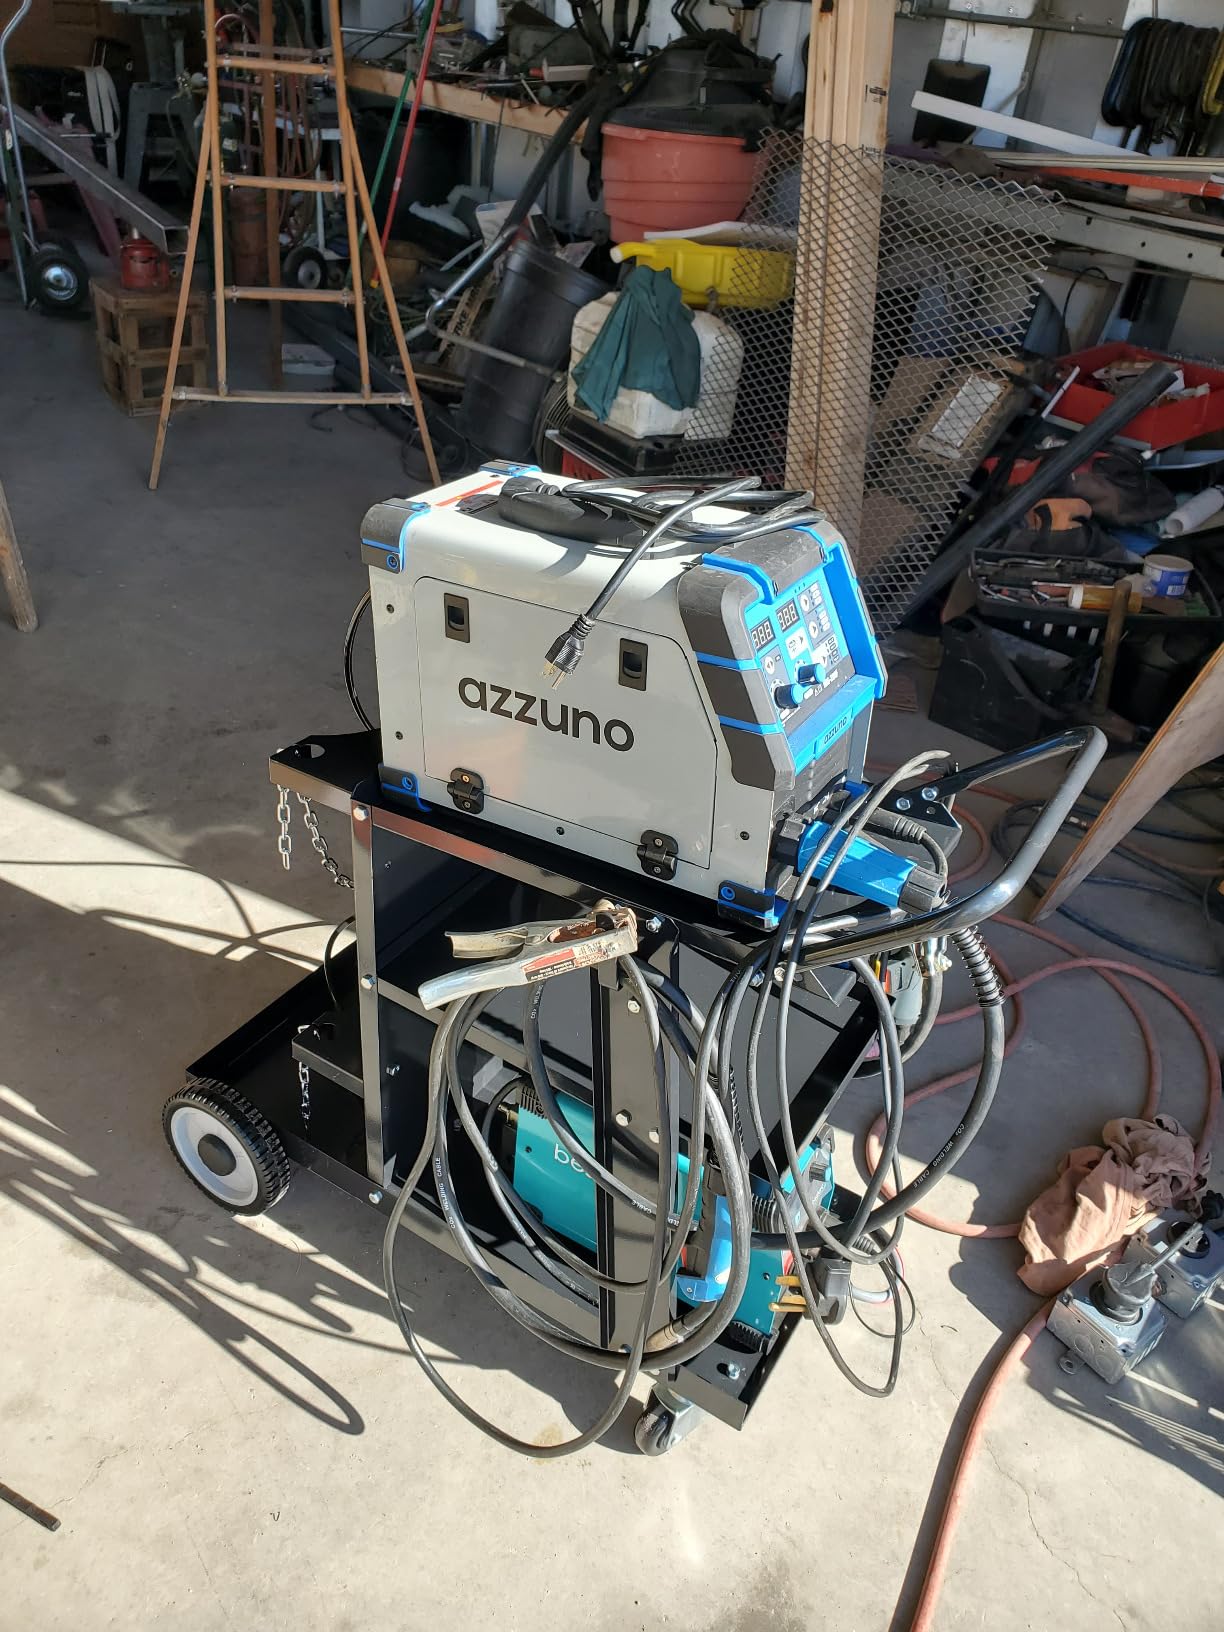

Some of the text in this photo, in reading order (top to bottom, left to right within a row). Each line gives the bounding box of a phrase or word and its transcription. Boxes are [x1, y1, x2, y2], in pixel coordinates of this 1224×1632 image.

[458, 677, 635, 752] azzuno
[824, 716, 847, 744] azzuno
[932, 1140, 954, 1167] WELDING
[913, 1169, 930, 1189] CABLE
[439, 1182, 449, 1210] WELDING
